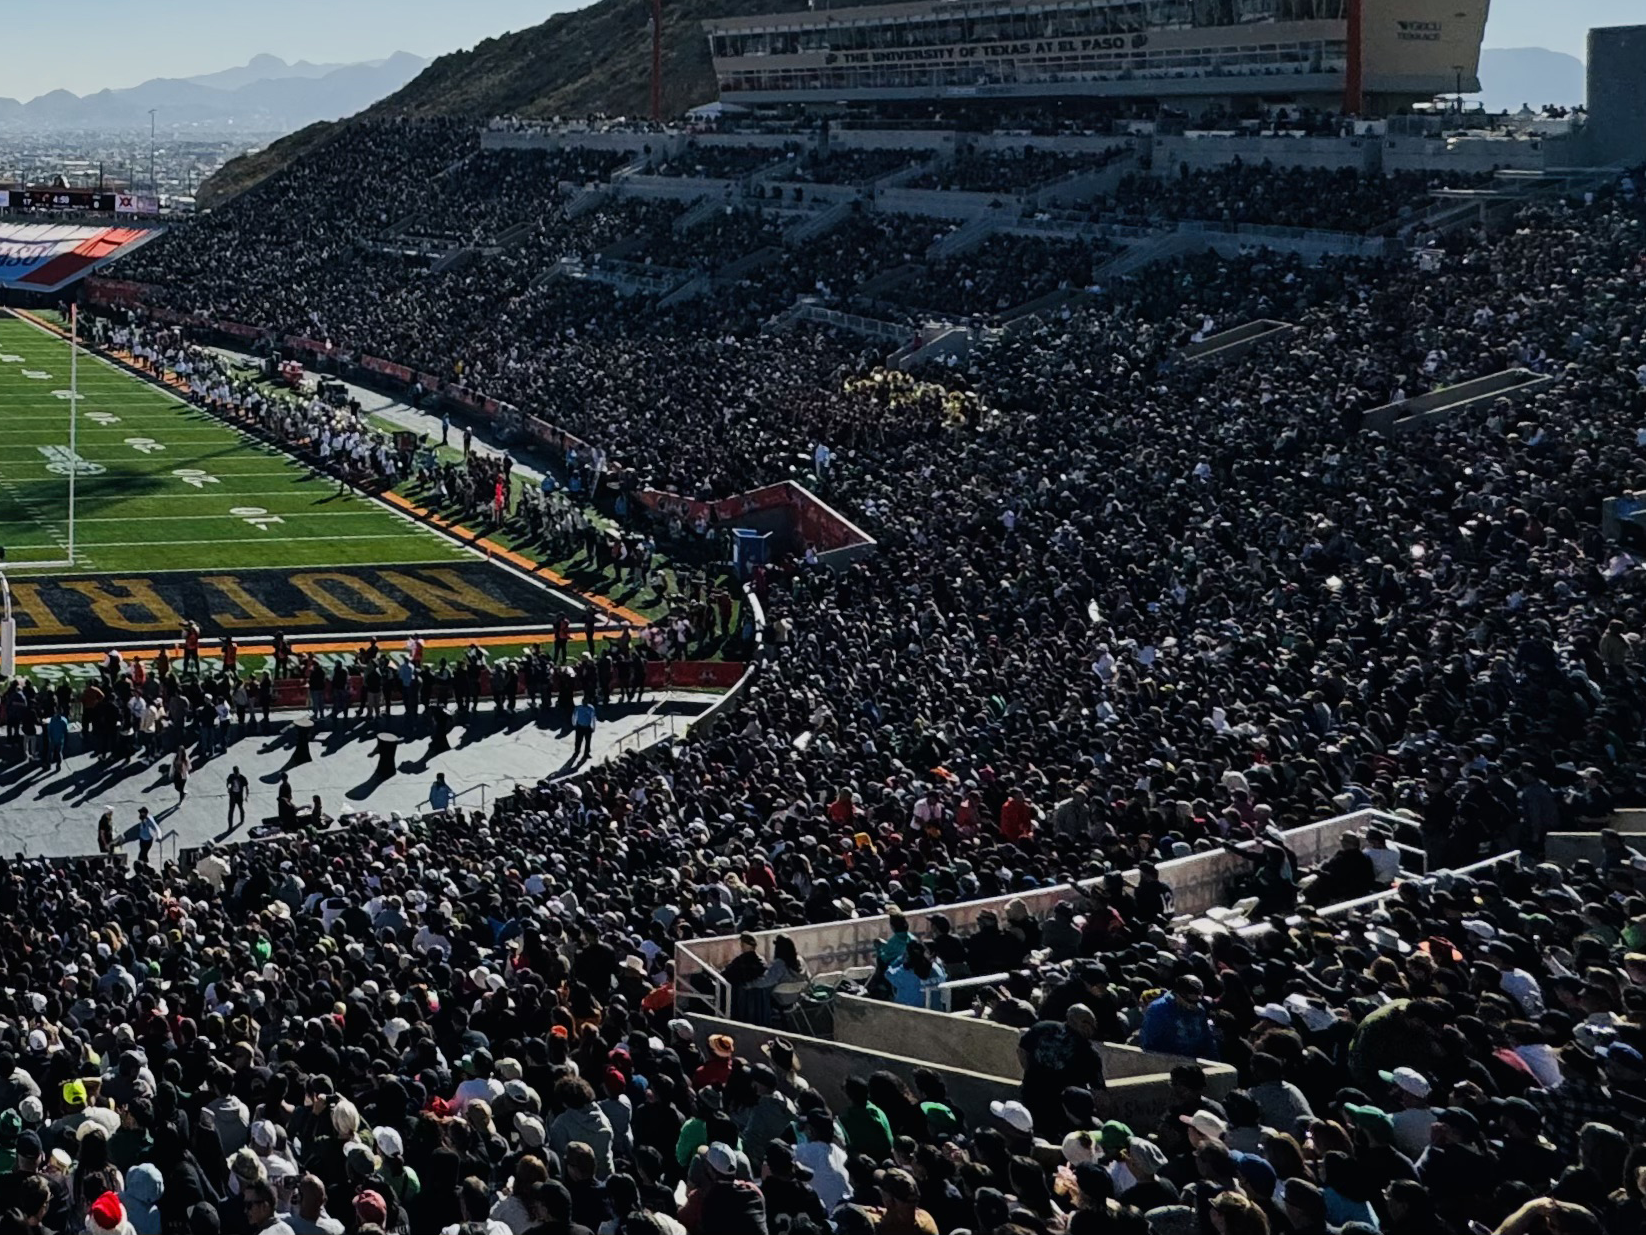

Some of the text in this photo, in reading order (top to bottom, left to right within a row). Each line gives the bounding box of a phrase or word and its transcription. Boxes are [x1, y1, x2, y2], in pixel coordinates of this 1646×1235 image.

[844, 37, 1125, 64] THE UNIVERSITY OF TEXAS AT EL PASO
[172, 469, 221, 483] 20
[229, 507, 285, 524] 10
